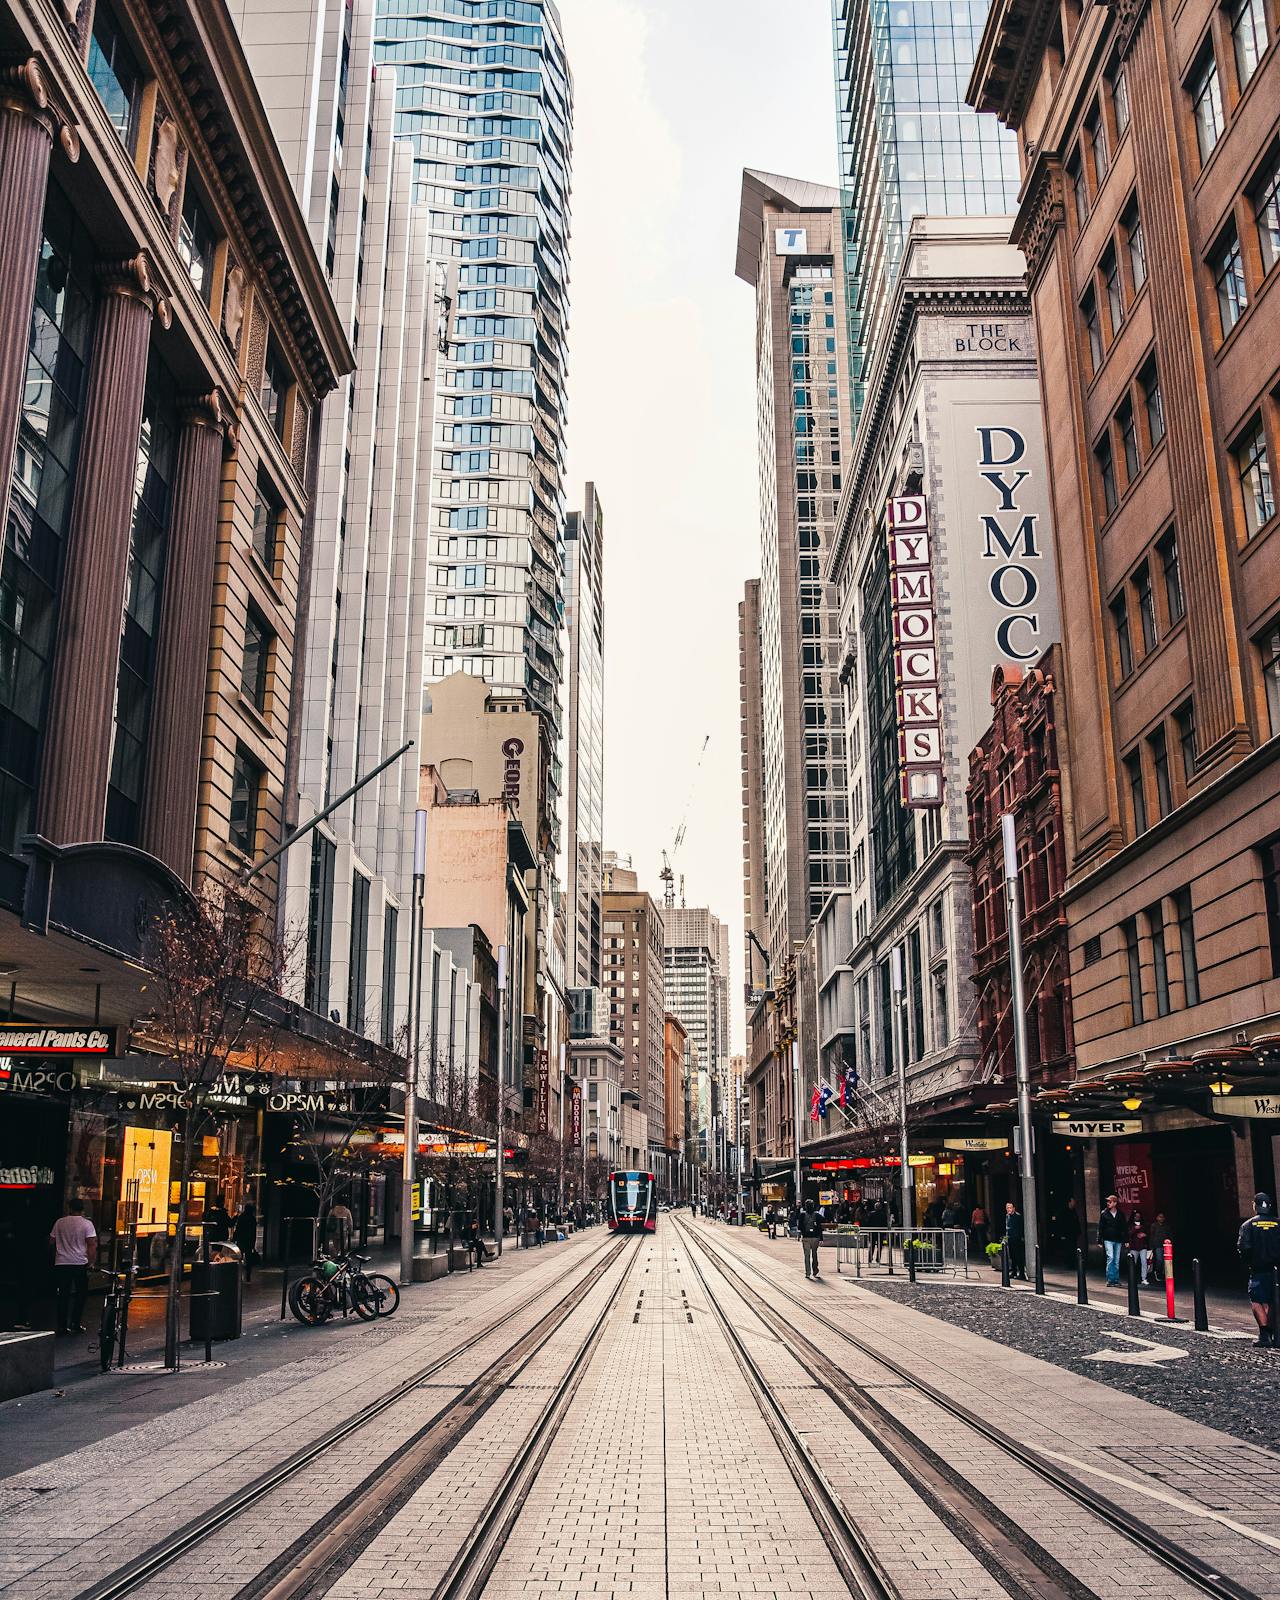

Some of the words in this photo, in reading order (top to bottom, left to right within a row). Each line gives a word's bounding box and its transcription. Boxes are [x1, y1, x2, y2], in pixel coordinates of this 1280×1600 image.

[784, 230, 802, 247] T
[966, 325, 1006, 338] THE
[955, 338, 1021, 352] BLOCK
[896, 500, 934, 758] DYMOCKS
[44, 1030, 87, 1048] Pants
[87, 1031, 110, 1048] Co.
[269, 1094, 325, 1111] OPSM
[573, 1093, 581, 1144] McDonald's
[1069, 1122, 1126, 1133] MYER
